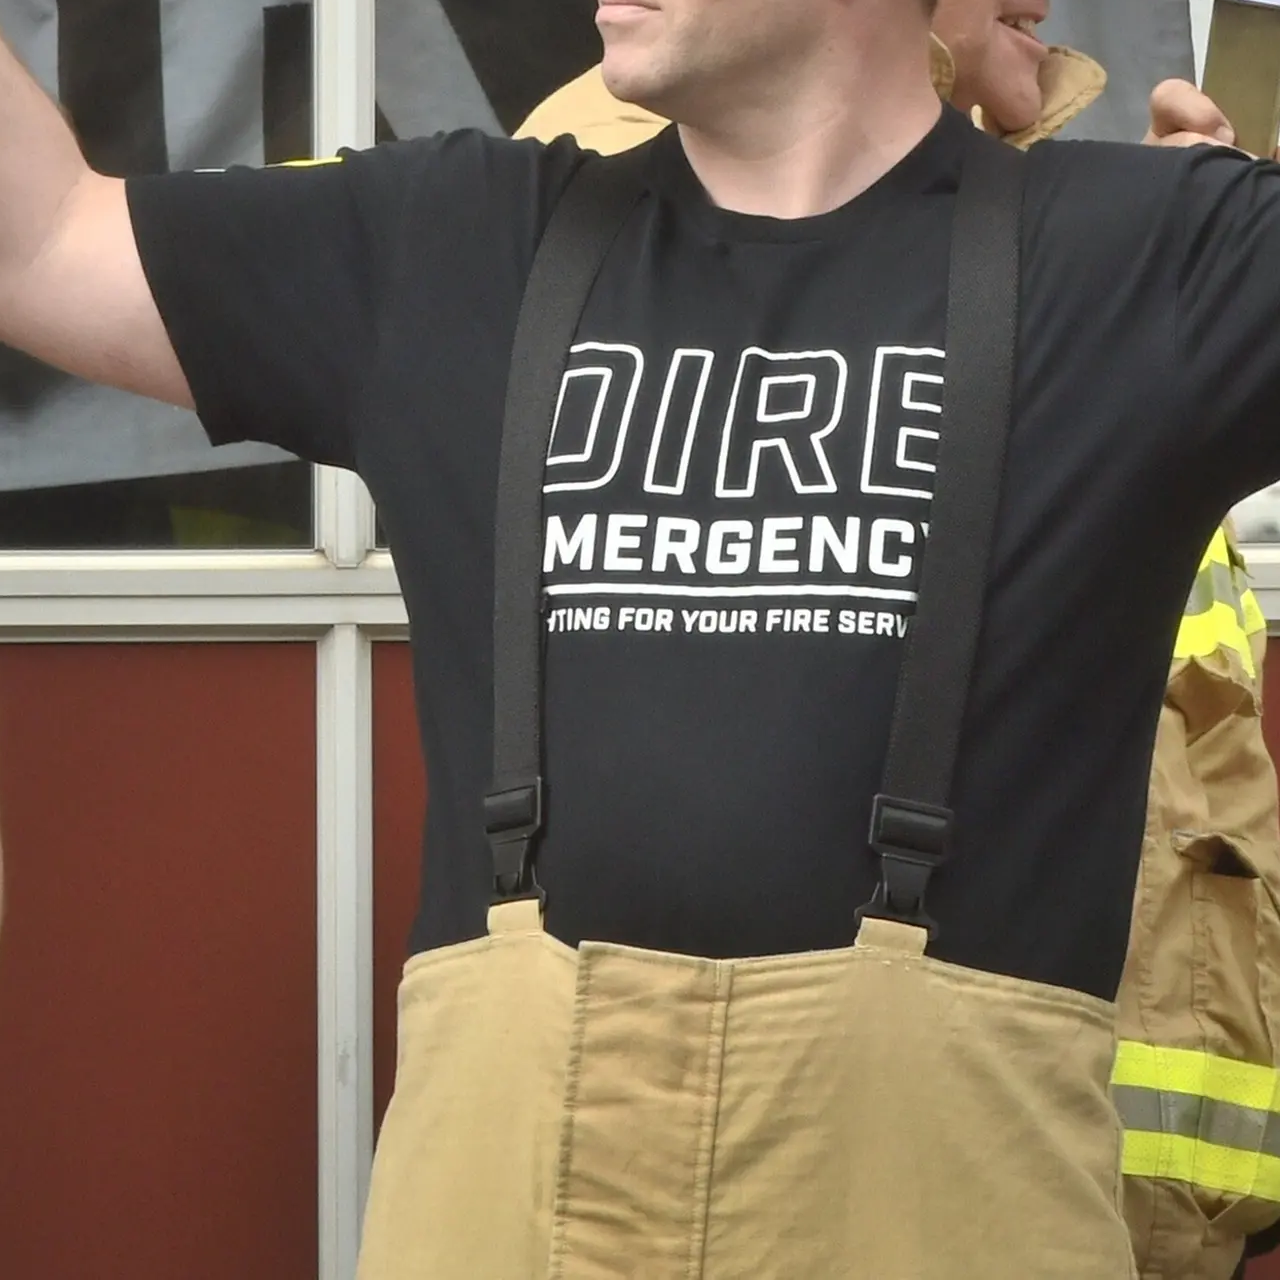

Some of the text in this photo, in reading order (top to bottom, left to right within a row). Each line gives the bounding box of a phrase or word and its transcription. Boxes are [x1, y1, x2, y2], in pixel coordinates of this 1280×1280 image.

[542, 513, 931, 578] MERGENC
[617, 606, 674, 632] FOR
[681, 608, 758, 634] YOUR
[765, 608, 831, 633] FIRE
